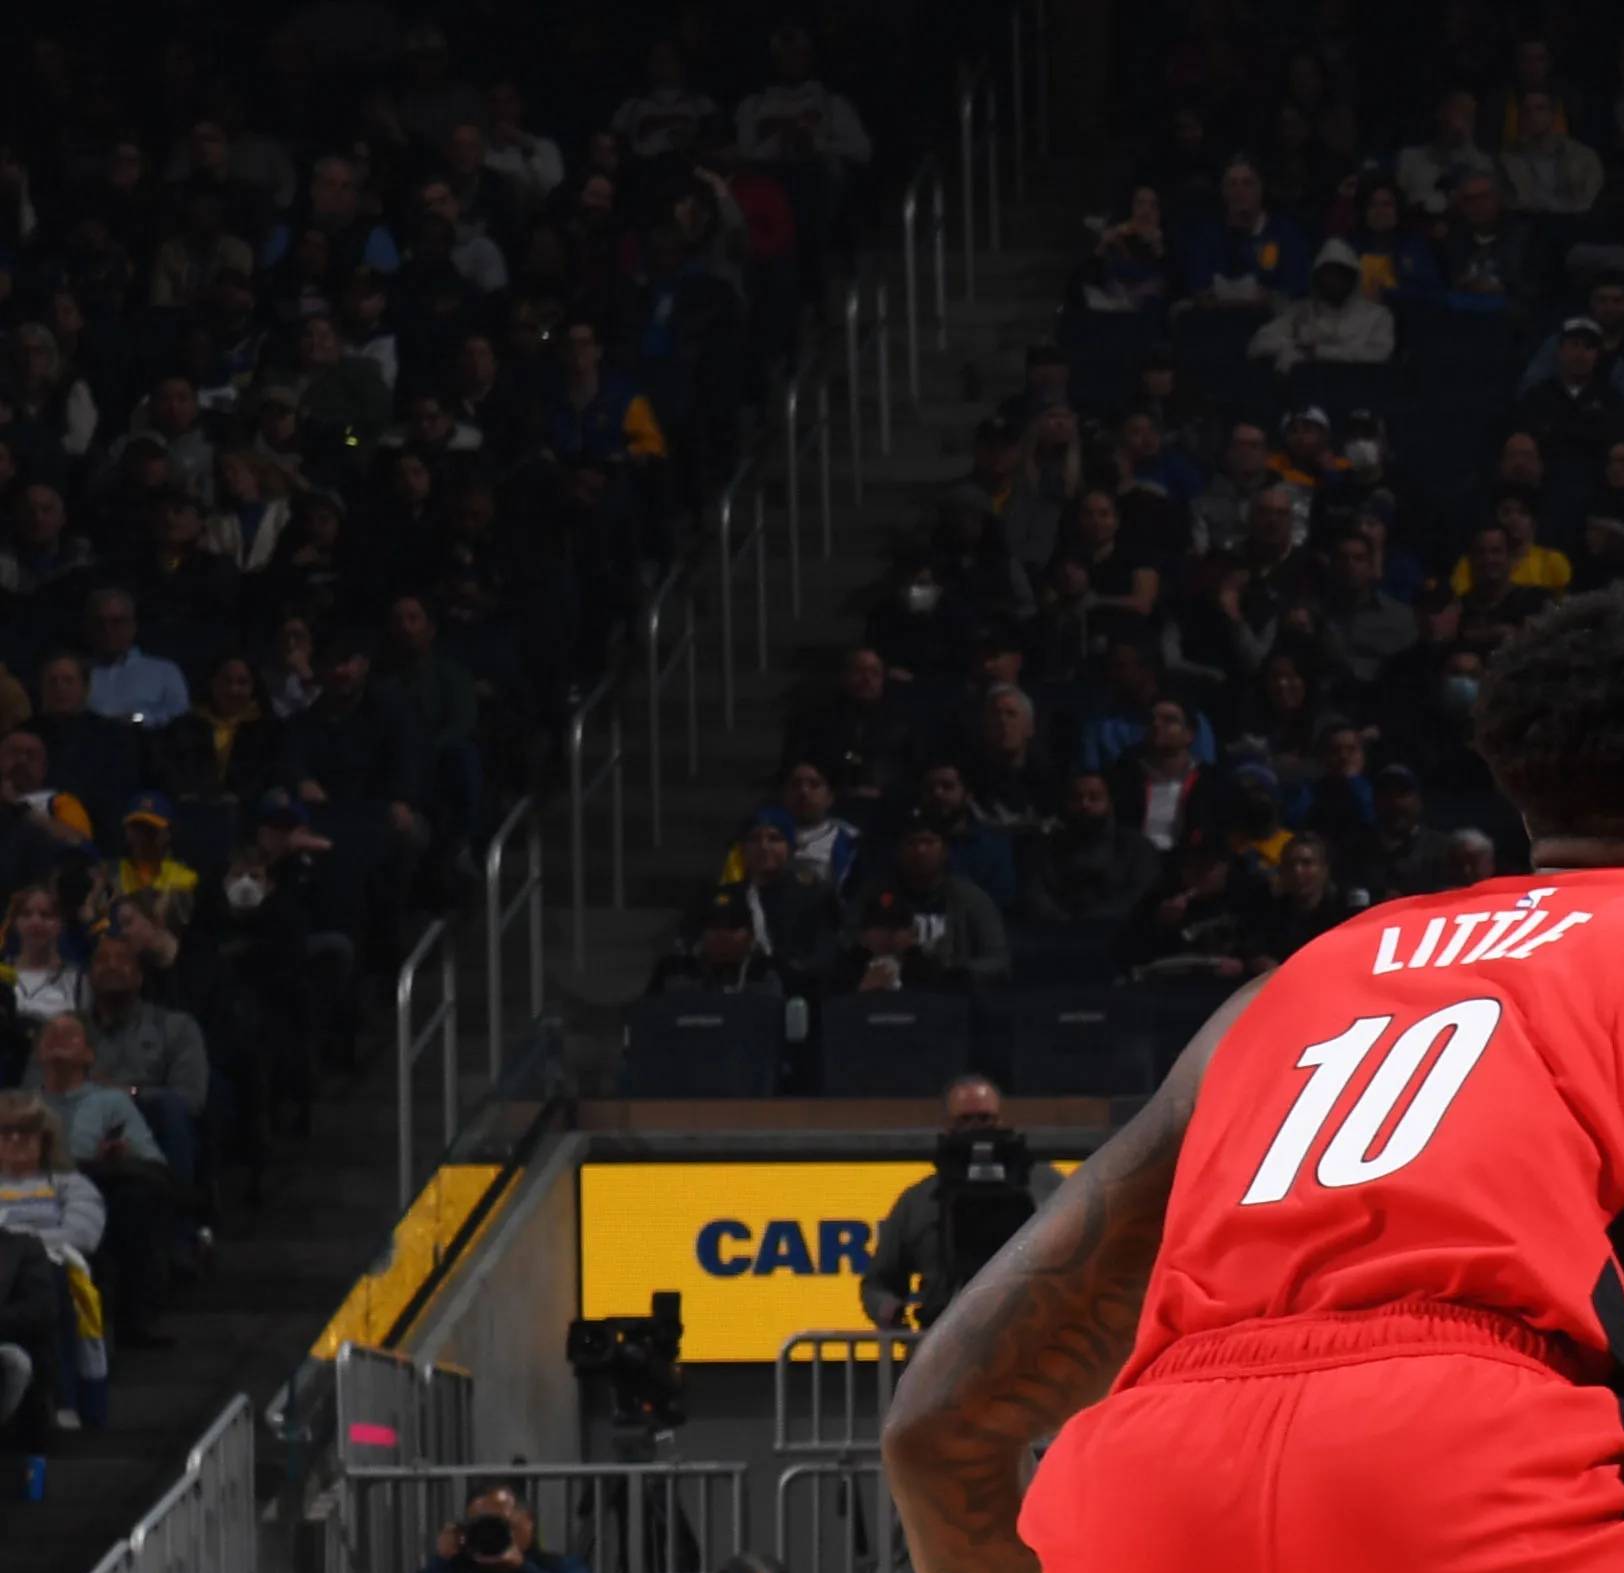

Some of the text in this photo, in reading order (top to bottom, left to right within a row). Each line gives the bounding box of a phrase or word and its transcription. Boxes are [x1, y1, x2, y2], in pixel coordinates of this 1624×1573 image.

[1373, 908, 1593, 976] LITTLE
[1240, 996, 1503, 1206] 10
[696, 1219, 874, 1277] CAR
